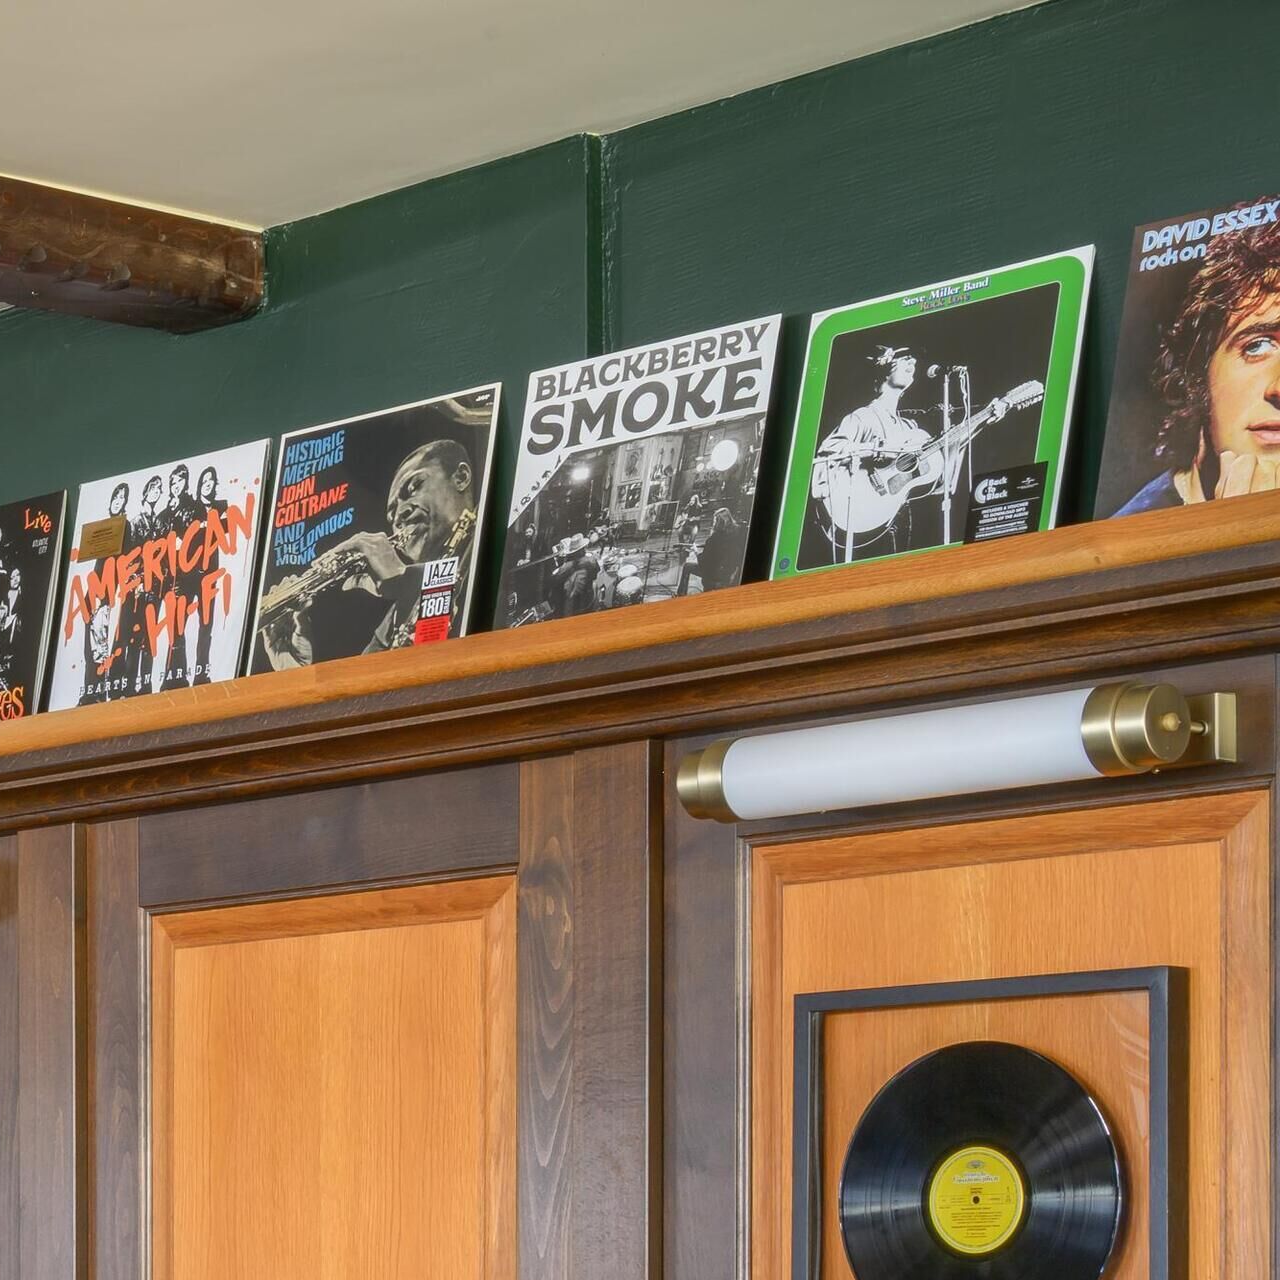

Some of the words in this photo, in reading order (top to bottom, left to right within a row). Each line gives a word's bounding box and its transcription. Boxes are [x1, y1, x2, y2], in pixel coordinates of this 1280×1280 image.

[1142, 218, 1211, 253] DAVID
[1211, 200, 1280, 236] ESSEX
[1139, 248, 1179, 272] rock
[1179, 243, 1207, 261] on
[902, 296, 926, 307] Steve
[928, 286, 961, 300] Miller
[963, 277, 991, 292] Band
[535, 322, 771, 403] BLACKBERRY
[526, 356, 763, 456] SMOKE
[285, 430, 345, 466] HISTORIC
[282, 446, 344, 487] MEETING
[275, 483, 349, 528] COLTRANE
[277, 476, 315, 508] JOHN
[24, 508, 52, 533] Live
[274, 521, 305, 546] AND
[274, 507, 355, 561] THELONIOUS
[64, 492, 255, 648] AMERICAN
[275, 543, 317, 566] MONK
[424, 561, 456, 587] JAZZ
[421, 597, 444, 618] 180
